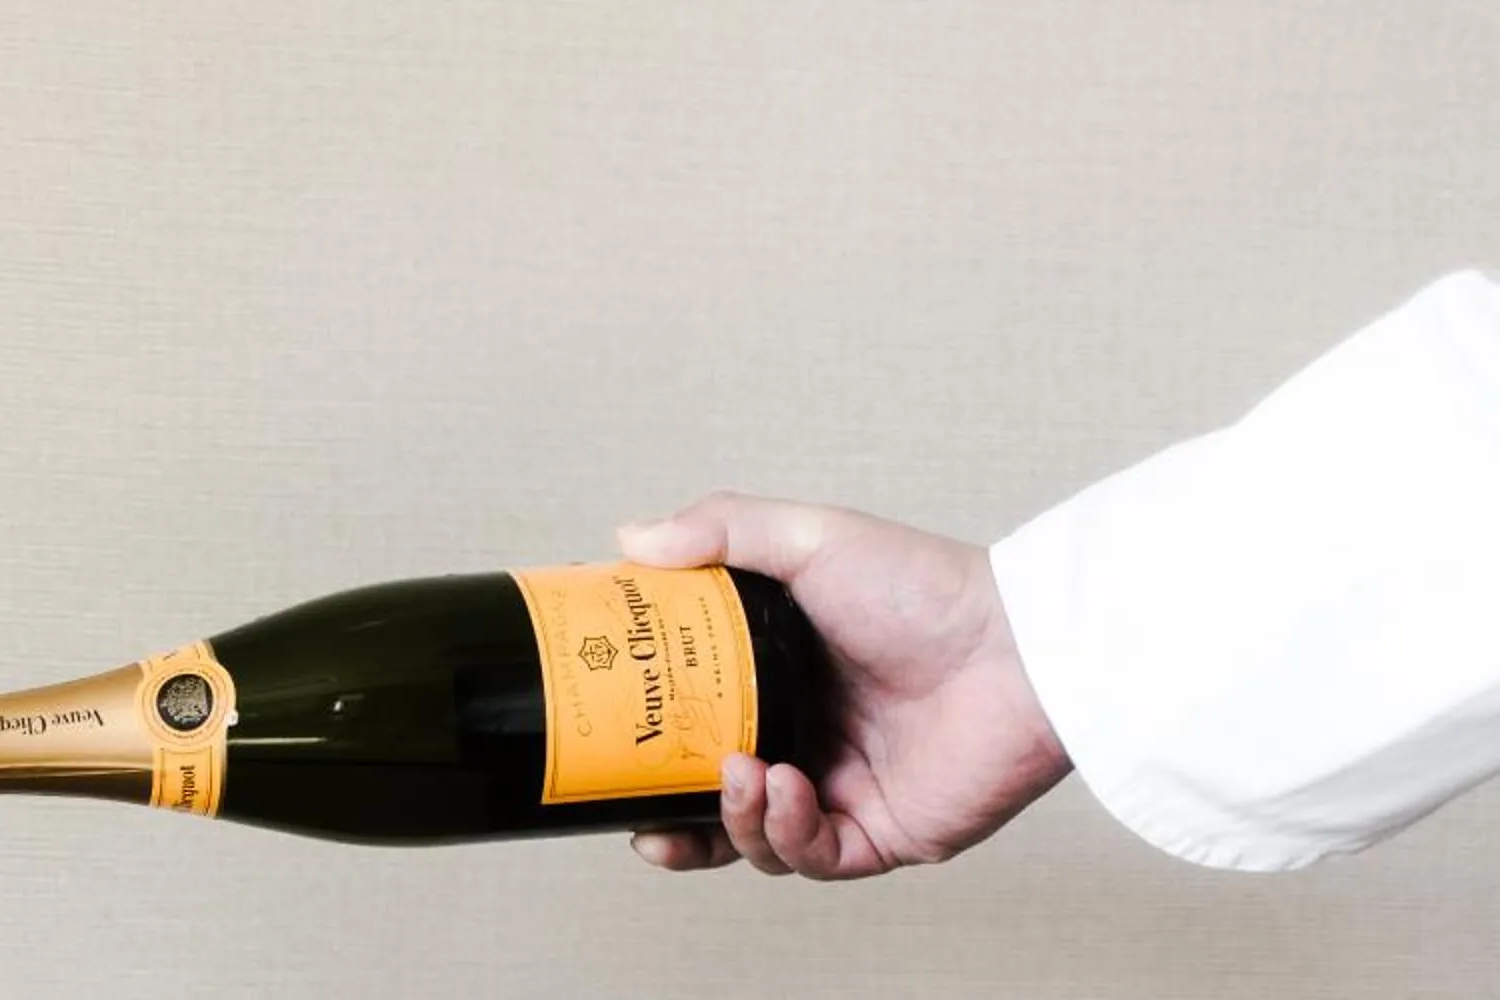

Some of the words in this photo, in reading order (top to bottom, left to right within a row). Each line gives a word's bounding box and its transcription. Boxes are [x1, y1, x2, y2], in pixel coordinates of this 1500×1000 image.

[613, 576, 657, 661] Clicquot
[679, 625, 699, 668] BRUT
[551, 589, 593, 738] CHAMPAGNE
[51, 708, 104, 728] Veuve
[635, 669, 663, 747] Veuve
